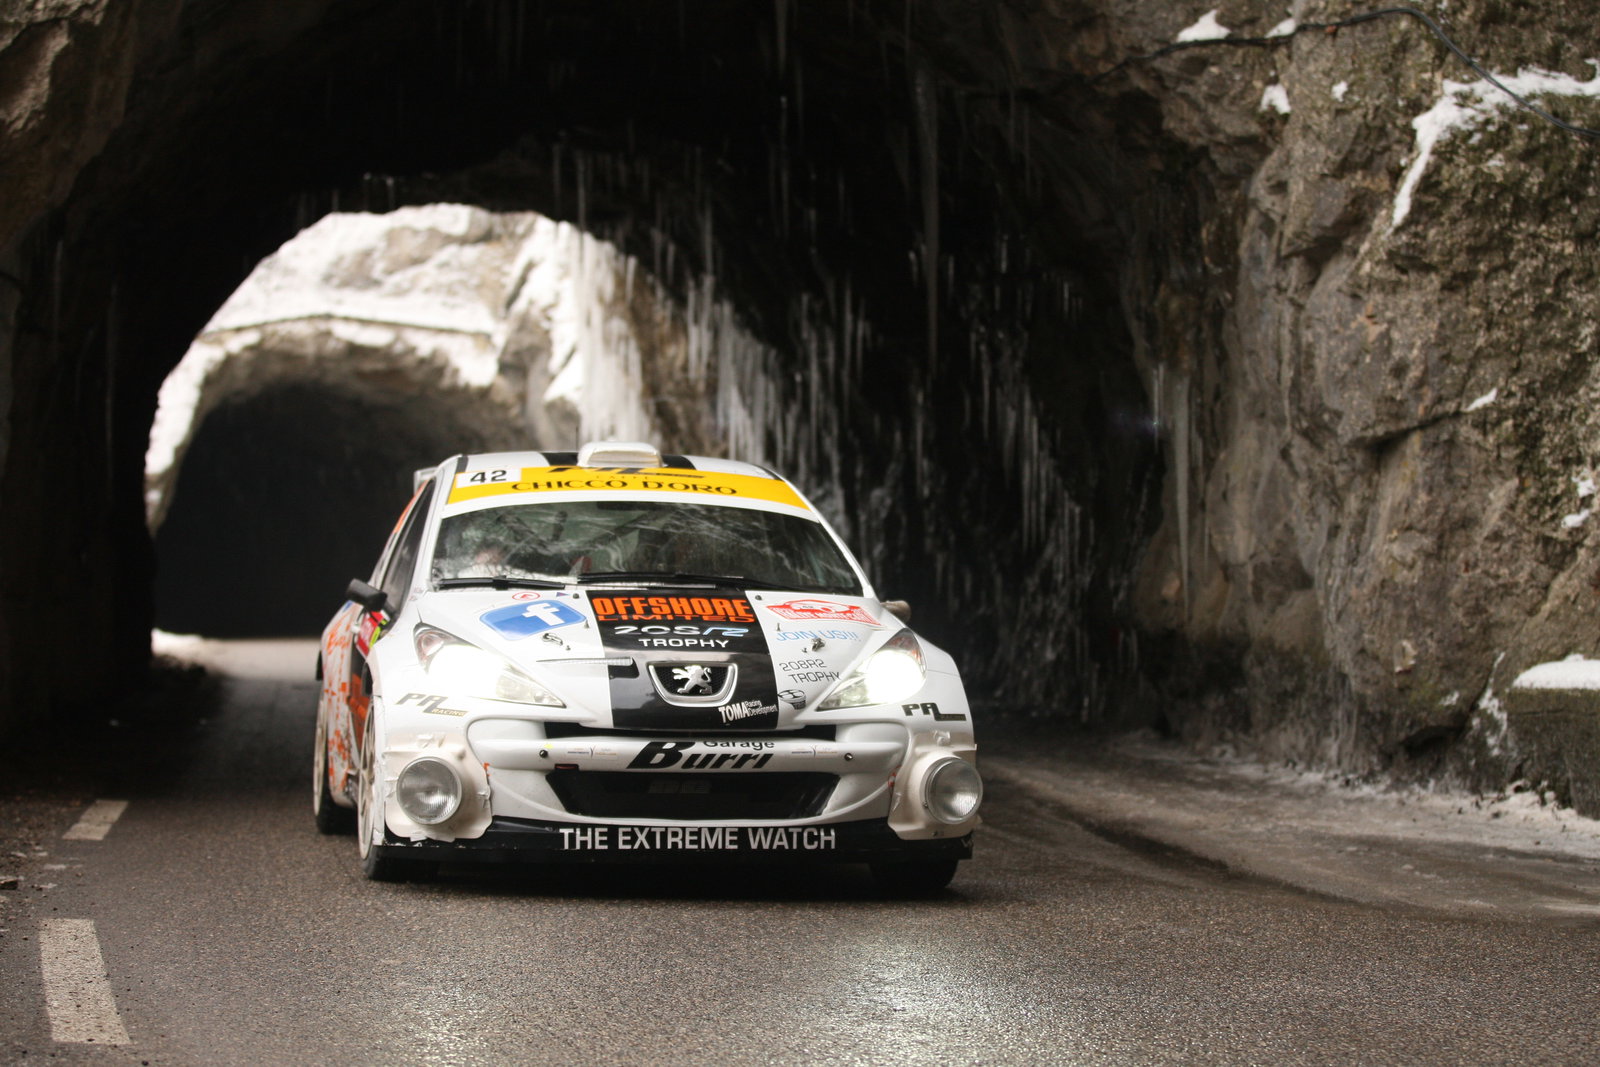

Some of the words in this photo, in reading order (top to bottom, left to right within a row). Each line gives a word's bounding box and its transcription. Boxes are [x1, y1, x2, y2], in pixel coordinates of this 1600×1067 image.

[469, 469, 507, 484] 42
[511, 479, 628, 492] CHICCO
[642, 480, 738, 495] D'ORO
[592, 597, 753, 617] OFFSHORE
[598, 614, 755, 622] LIMITED
[638, 638, 729, 648] TROPHY
[777, 630, 818, 642] JOIN
[818, 630, 861, 642] US!!!
[779, 658, 827, 672] 208R2
[788, 671, 841, 684] TROPHY
[718, 701, 750, 723] TOMA
[703, 740, 776, 750] Garage
[626, 741, 775, 770] Burri
[559, 827, 608, 850] THE
[617, 827, 738, 850] EXTREME
[748, 827, 836, 850] WATCH
